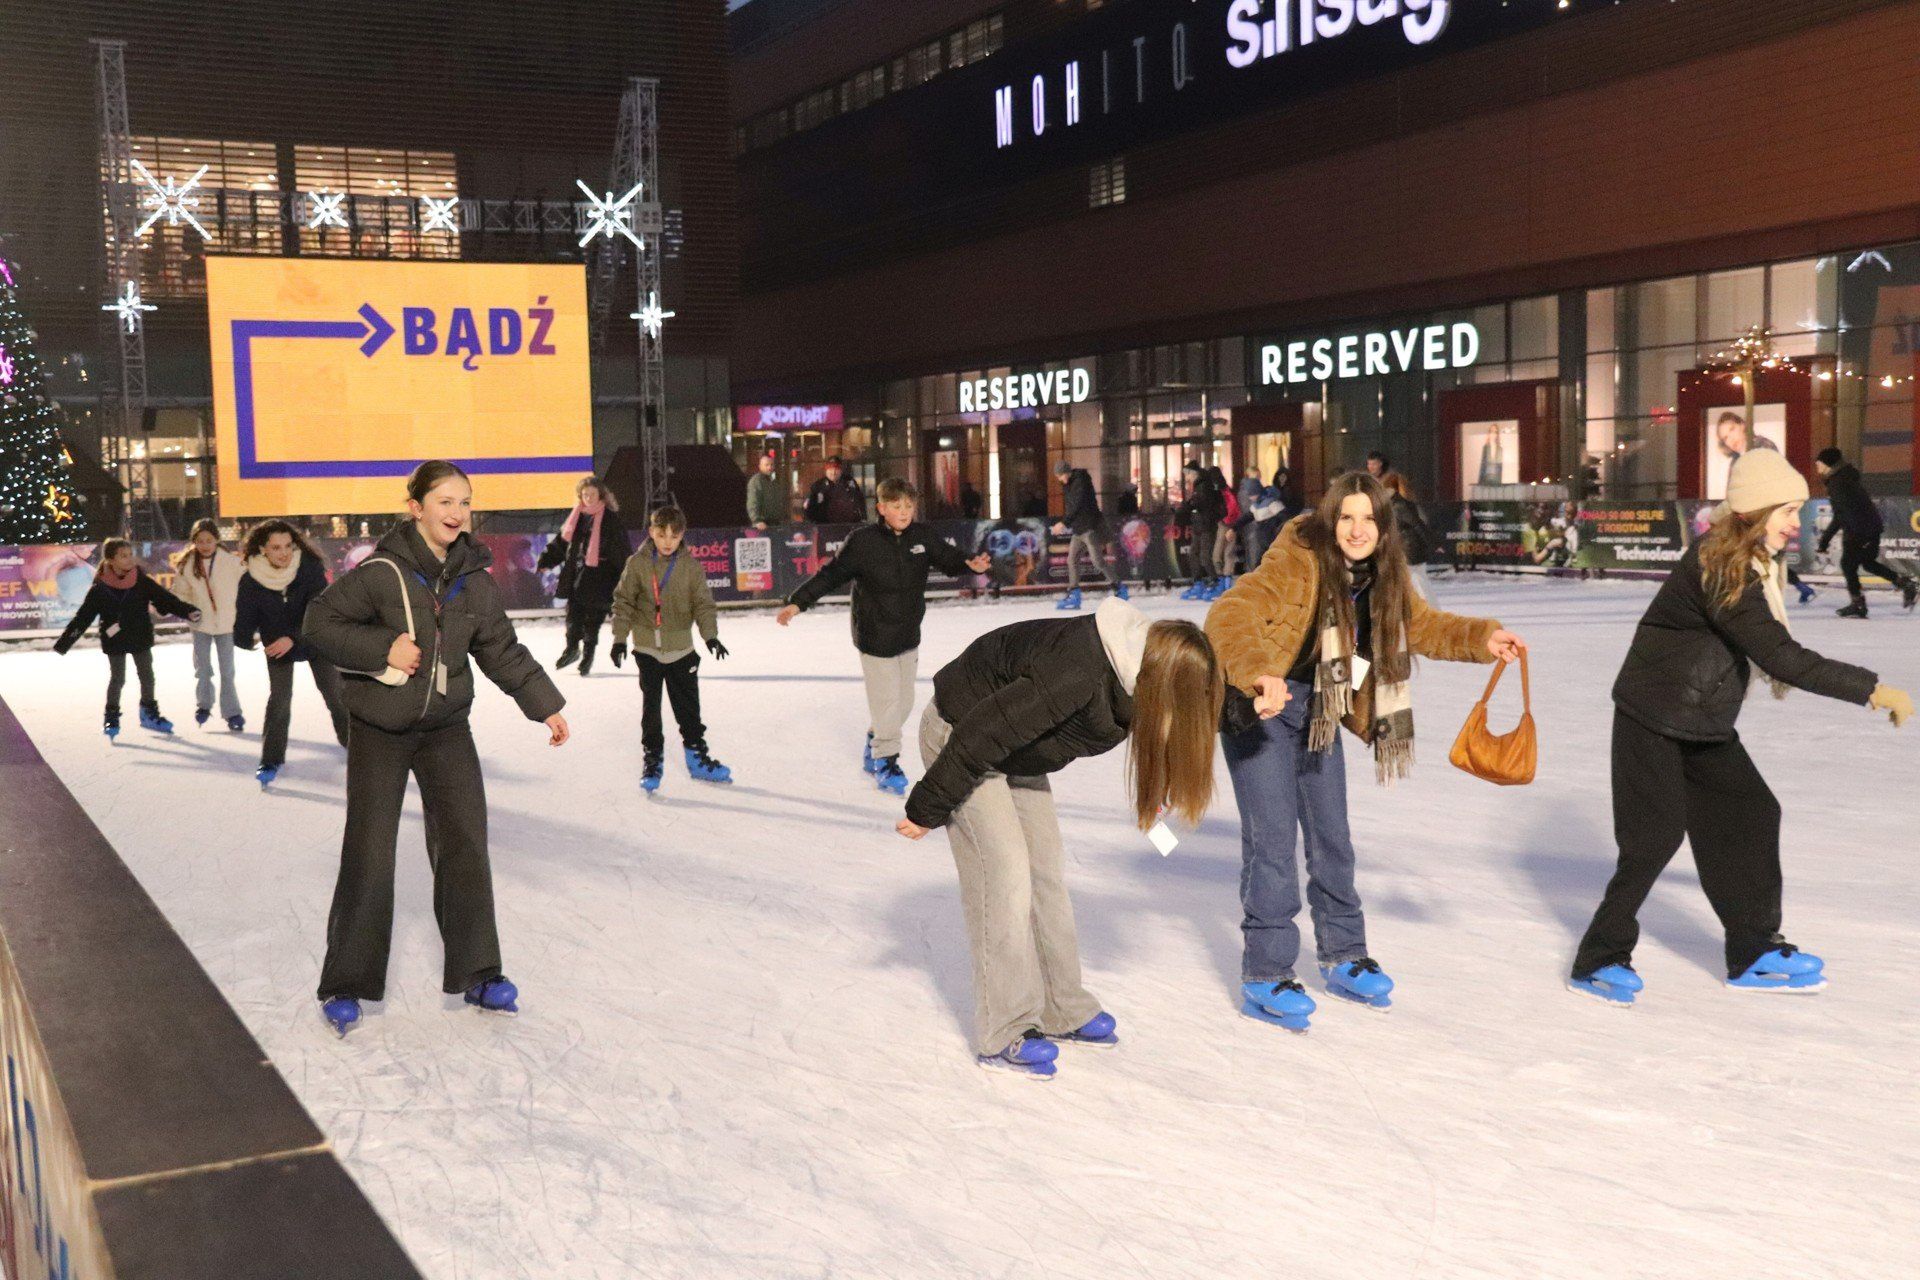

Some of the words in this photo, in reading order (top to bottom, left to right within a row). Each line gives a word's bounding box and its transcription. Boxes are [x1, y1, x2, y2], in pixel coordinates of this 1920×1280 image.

[995, 22, 1190, 149] MOHITO
[402, 296, 557, 371] BĄDŹ
[1260, 321, 1480, 385] RESERVED
[958, 367, 1091, 413] RESERVED
